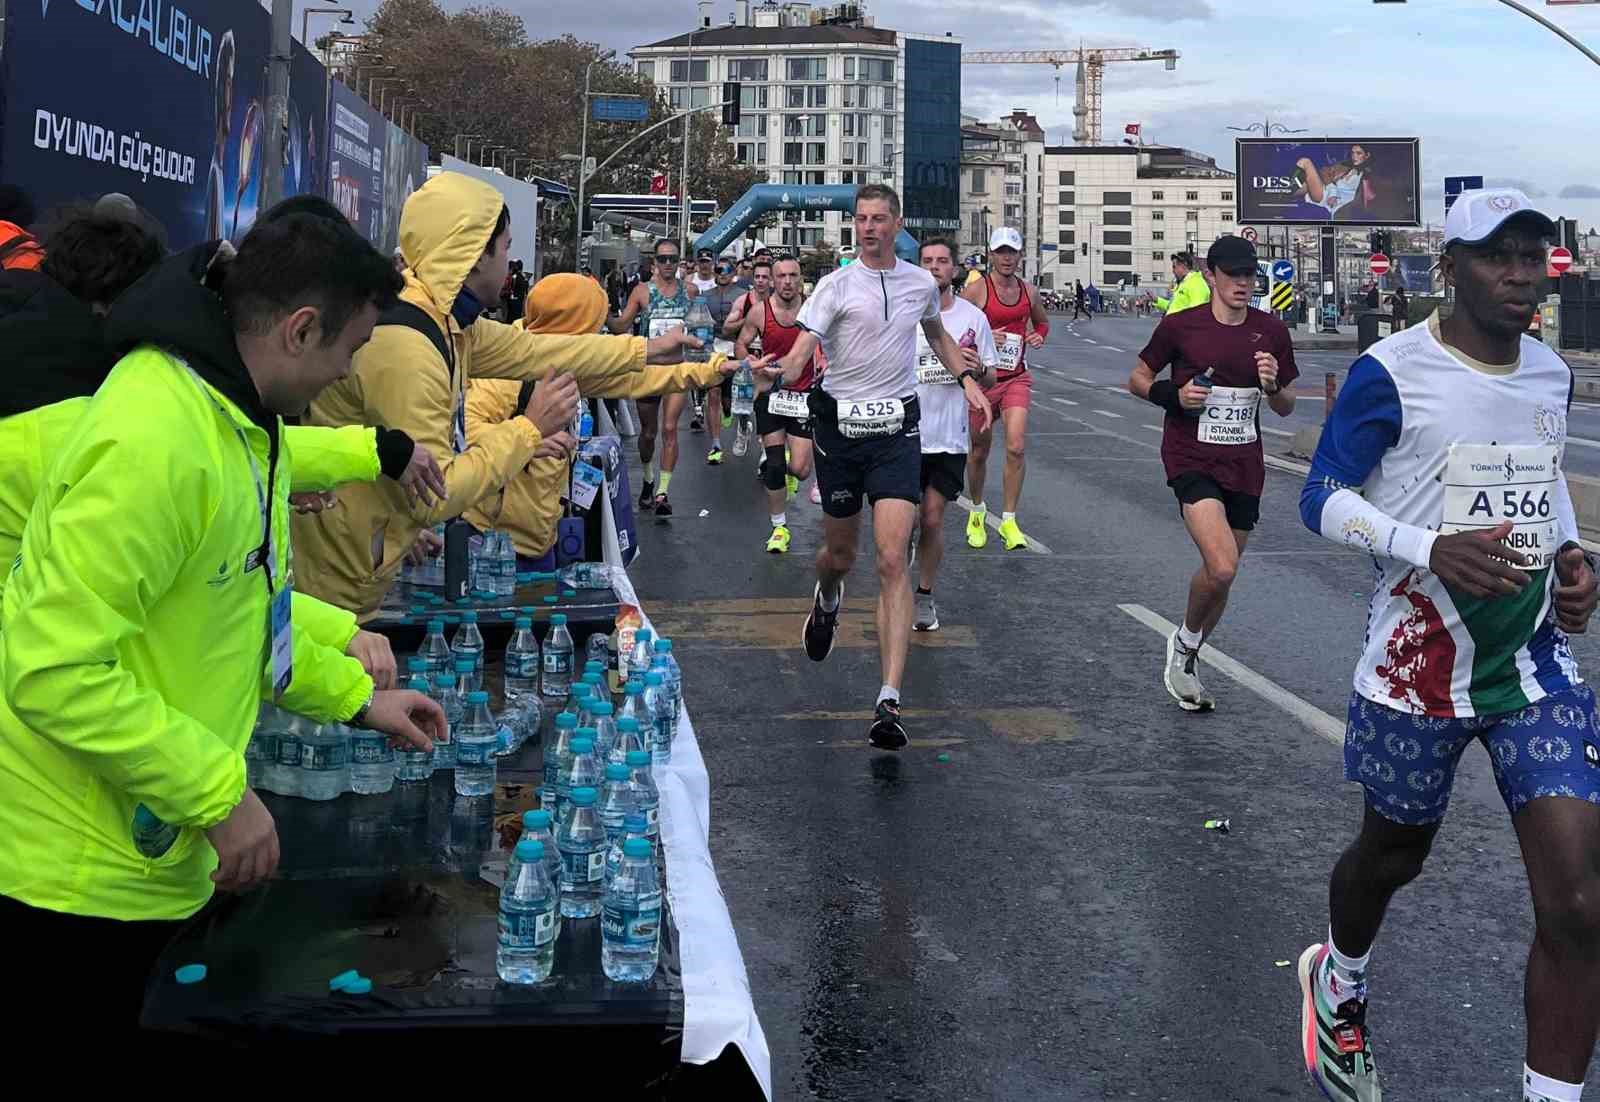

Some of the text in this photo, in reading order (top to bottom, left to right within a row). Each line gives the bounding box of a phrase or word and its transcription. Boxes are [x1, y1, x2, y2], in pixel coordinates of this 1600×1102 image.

[75, 0, 212, 79] CALIBUR
[34, 109, 115, 165] OYUNDA
[119, 132, 152, 183] GÜÇ
[1253, 176, 1303, 188] DESA
[919, 356, 927, 366] E
[850, 402, 895, 416] A 525
[1208, 407, 1220, 419] C
[1468, 490, 1550, 518] A 566
